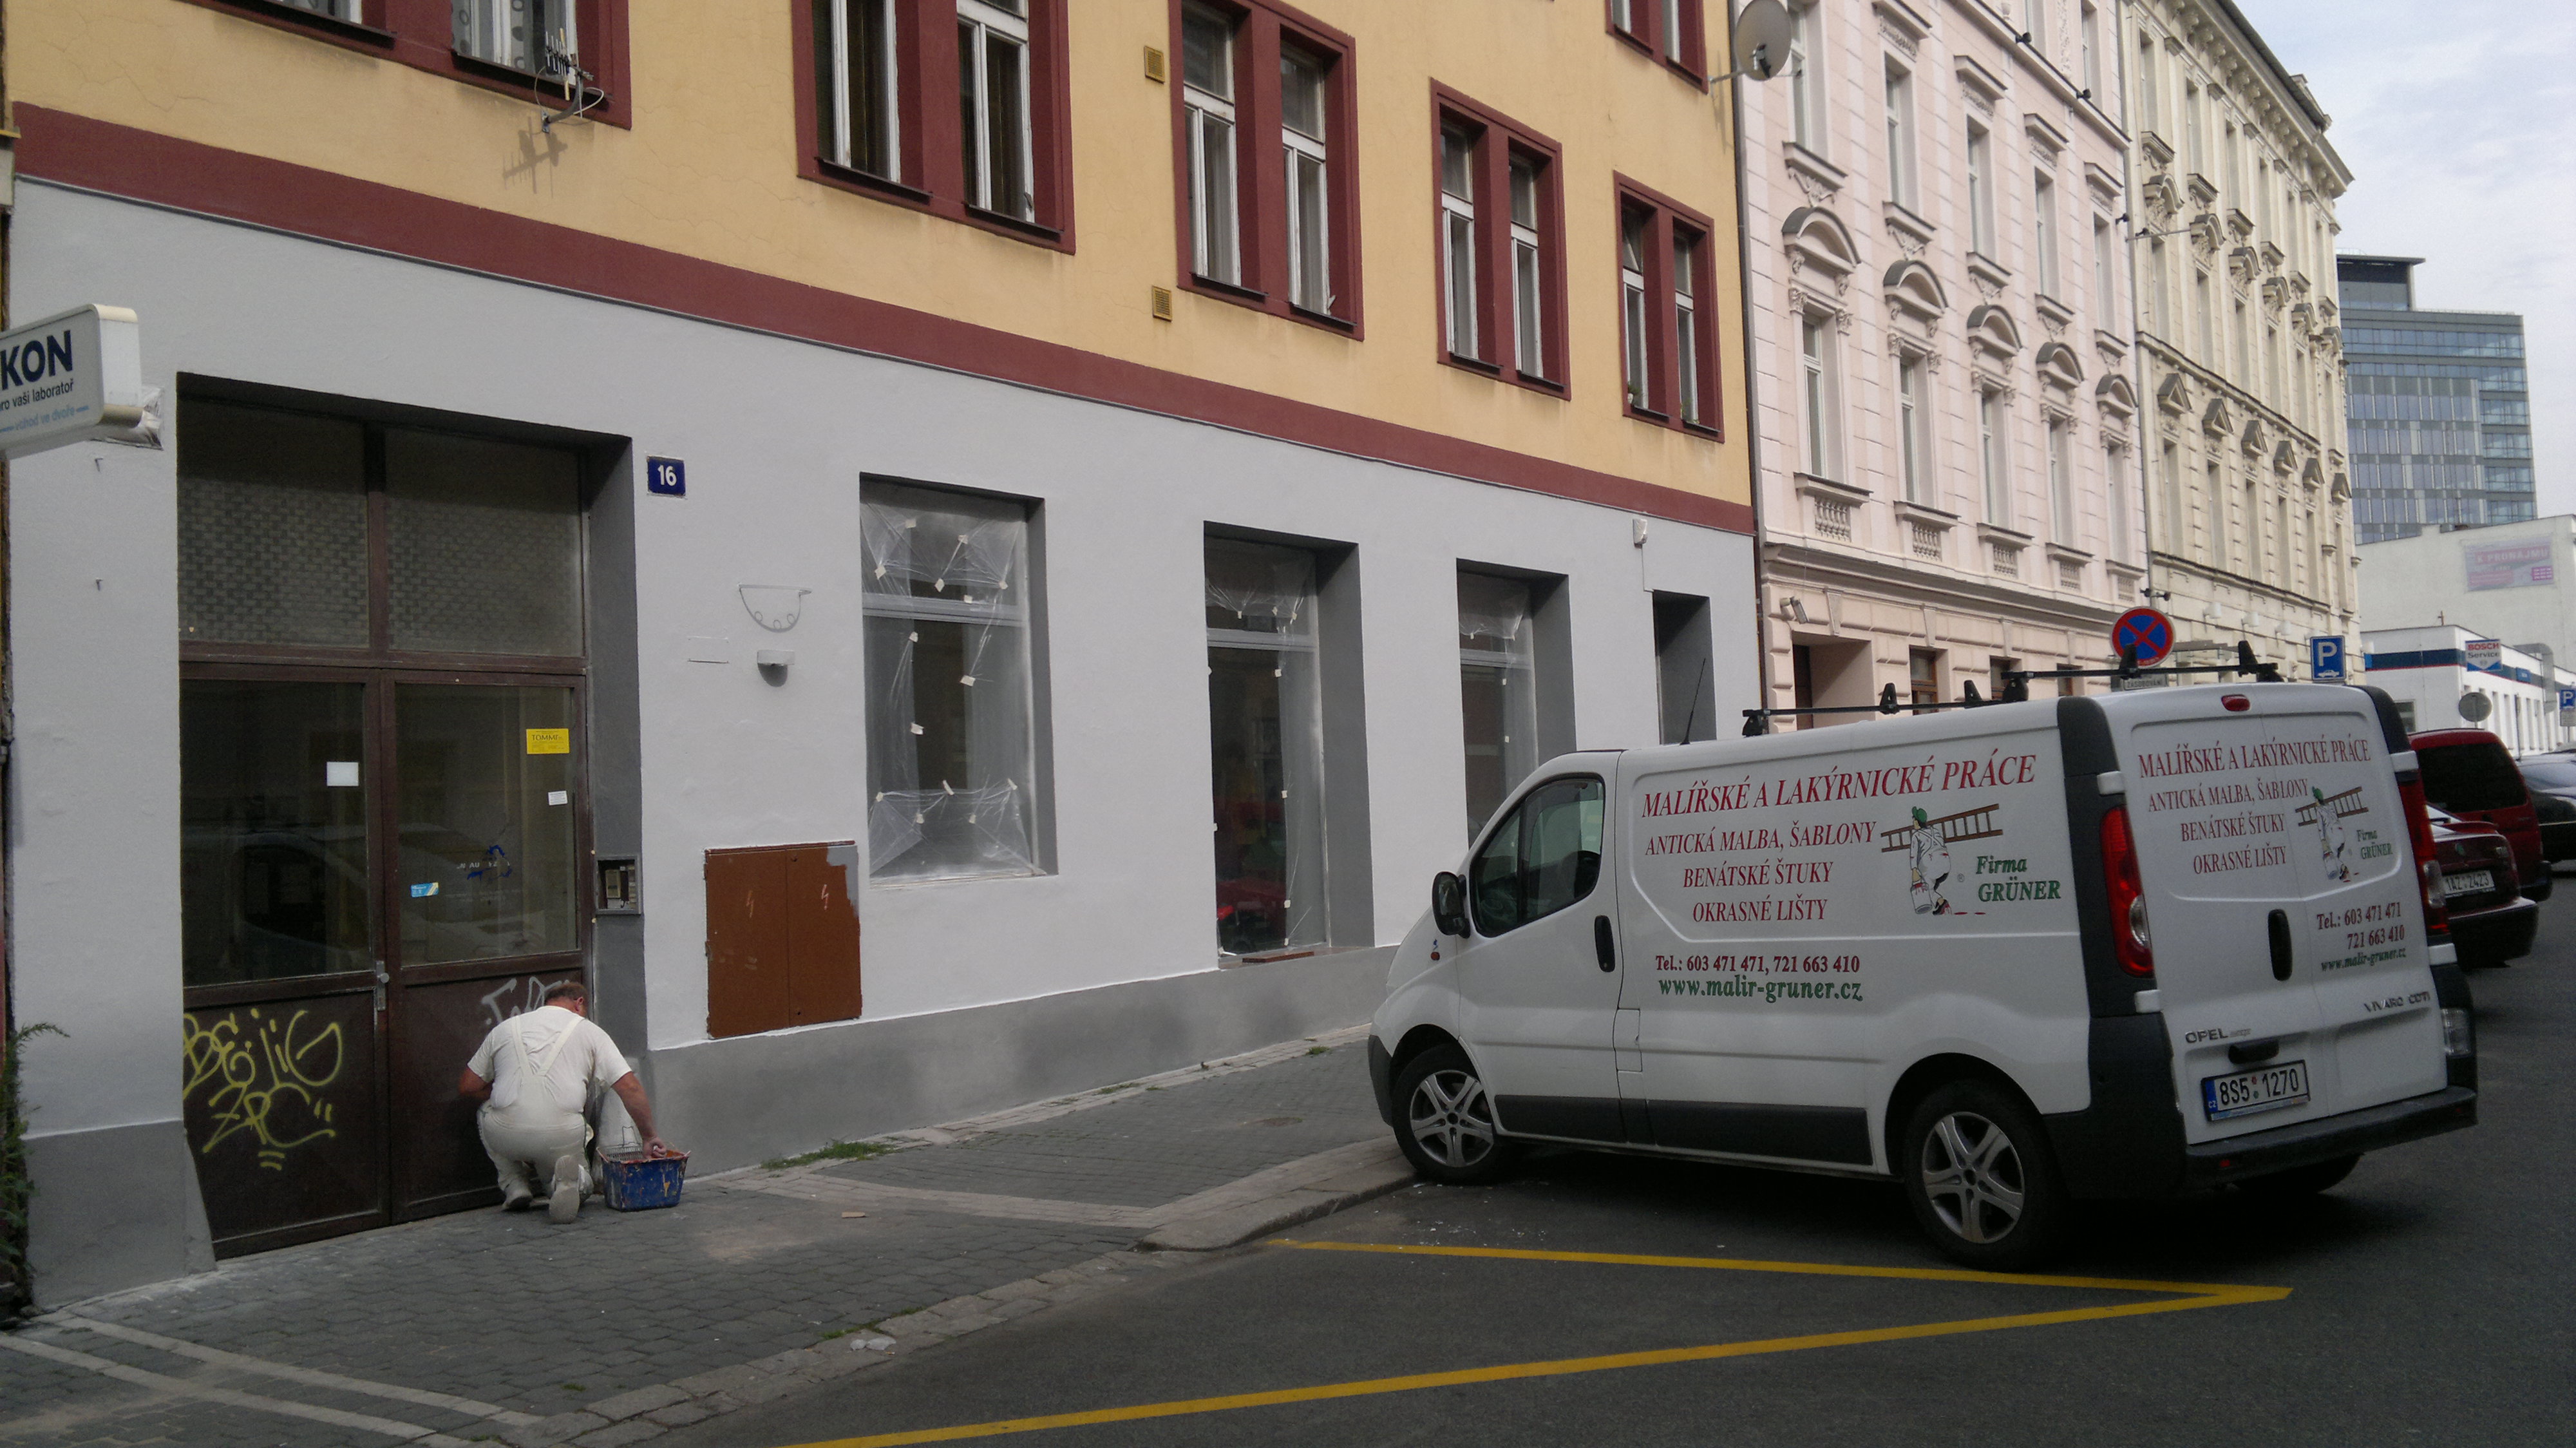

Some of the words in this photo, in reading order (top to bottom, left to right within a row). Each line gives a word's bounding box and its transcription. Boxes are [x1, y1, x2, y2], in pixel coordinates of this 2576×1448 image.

[13, 390, 30, 407] vaši
[33, 378, 73, 402] laboratoř
[658, 464, 677, 486] 16
[2318, 642, 2338, 667] P
[2563, 691, 2573, 704] P
[2138, 740, 2225, 778] MALÍŘSKÉ
[2229, 747, 2239, 770] A
[2241, 734, 2330, 768] LAKÝRNICKÉ
[2331, 733, 2371, 763] PRÁCE
[1642, 775, 1750, 818] MALÍŘSKÉ
[1753, 781, 1769, 808] A
[1775, 755, 1935, 806] LAKÝRNICKÉ
[1941, 748, 2037, 791] PRÁCE
[2148, 783, 2206, 812] ANTICKÁ
[2208, 784, 2255, 806] MALBA,
[2257, 777, 2308, 801] ŠABLONY
[1645, 826, 1715, 855] ANTICKÁ
[1719, 828, 1785, 852] MALBA,
[1790, 820, 1877, 848] ŠABLONY
[2181, 812, 2246, 842] BENÁTSKÉ
[2248, 810, 2284, 835] ŠTUKY
[2356, 829, 2378, 842] Firma
[2193, 844, 2253, 875] OKRASNÉ
[2255, 842, 2286, 867] LIŠTY
[2361, 842, 2392, 860] GRÜNER
[1683, 859, 1770, 888] BENÁTSKÉ
[1775, 858, 1833, 885] ŠTUKY
[1976, 855, 2027, 874] Firma
[1978, 876, 2061, 902] GRÜNER
[1693, 894, 1772, 922] OKRASNÉ
[1777, 893, 1828, 921] LIŠTY
[2316, 913, 2341, 929] Tel.:
[2344, 908, 2362, 926] 603
[2365, 905, 2382, 921] 471
[2385, 902, 2401, 918] 471
[2347, 932, 2365, 949] 721
[2369, 928, 2385, 946] 663
[2389, 925, 2405, 942] 410
[1656, 955, 1683, 971] Tel.:
[1687, 955, 1709, 971] 603
[1713, 955, 1736, 971] 471
[1741, 956, 1769, 975] 471,
[1773, 956, 1798, 972] 721
[1803, 956, 1828, 973] 663
[1833, 956, 1861, 973] 410
[2321, 948, 2407, 971] www.malir-gruner.cz
[1659, 975, 1863, 1004] www.malir-gruner.cz
[2363, 996, 2403, 1012] VIVARO
[2185, 1028, 2228, 1043] OPEL
[2219, 1078, 2250, 1105] 8S5
[2262, 1068, 2298, 1098] 1270
[2208, 1100, 2217, 1109] CZ
